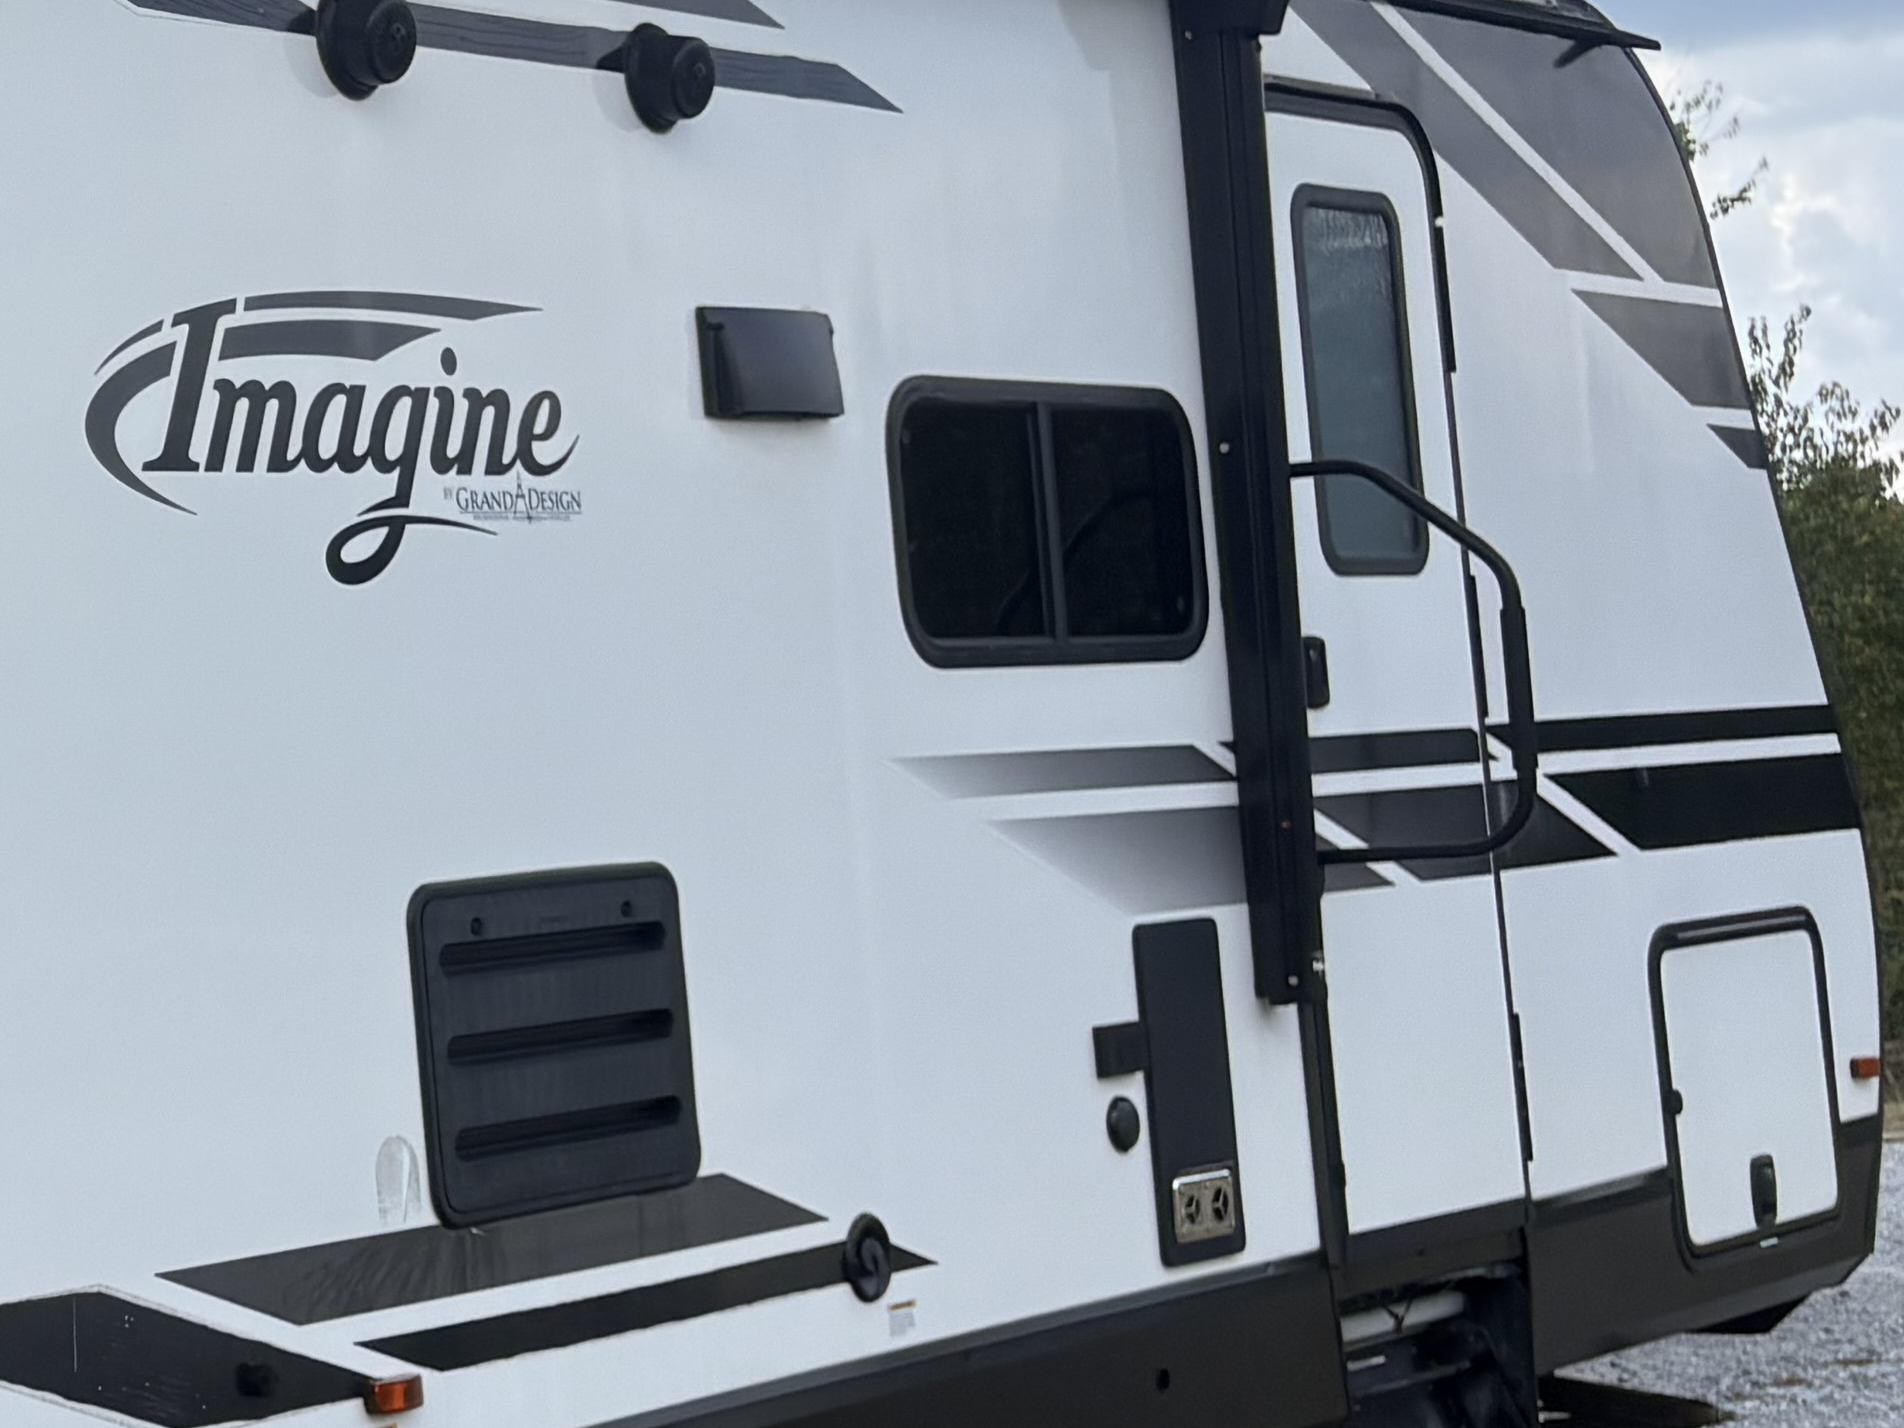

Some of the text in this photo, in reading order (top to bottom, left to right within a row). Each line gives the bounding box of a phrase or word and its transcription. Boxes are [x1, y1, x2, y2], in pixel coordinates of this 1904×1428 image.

[142, 298, 580, 585] Imagine
[456, 487, 514, 511] GRAND
[528, 488, 582, 511] DESIGN
